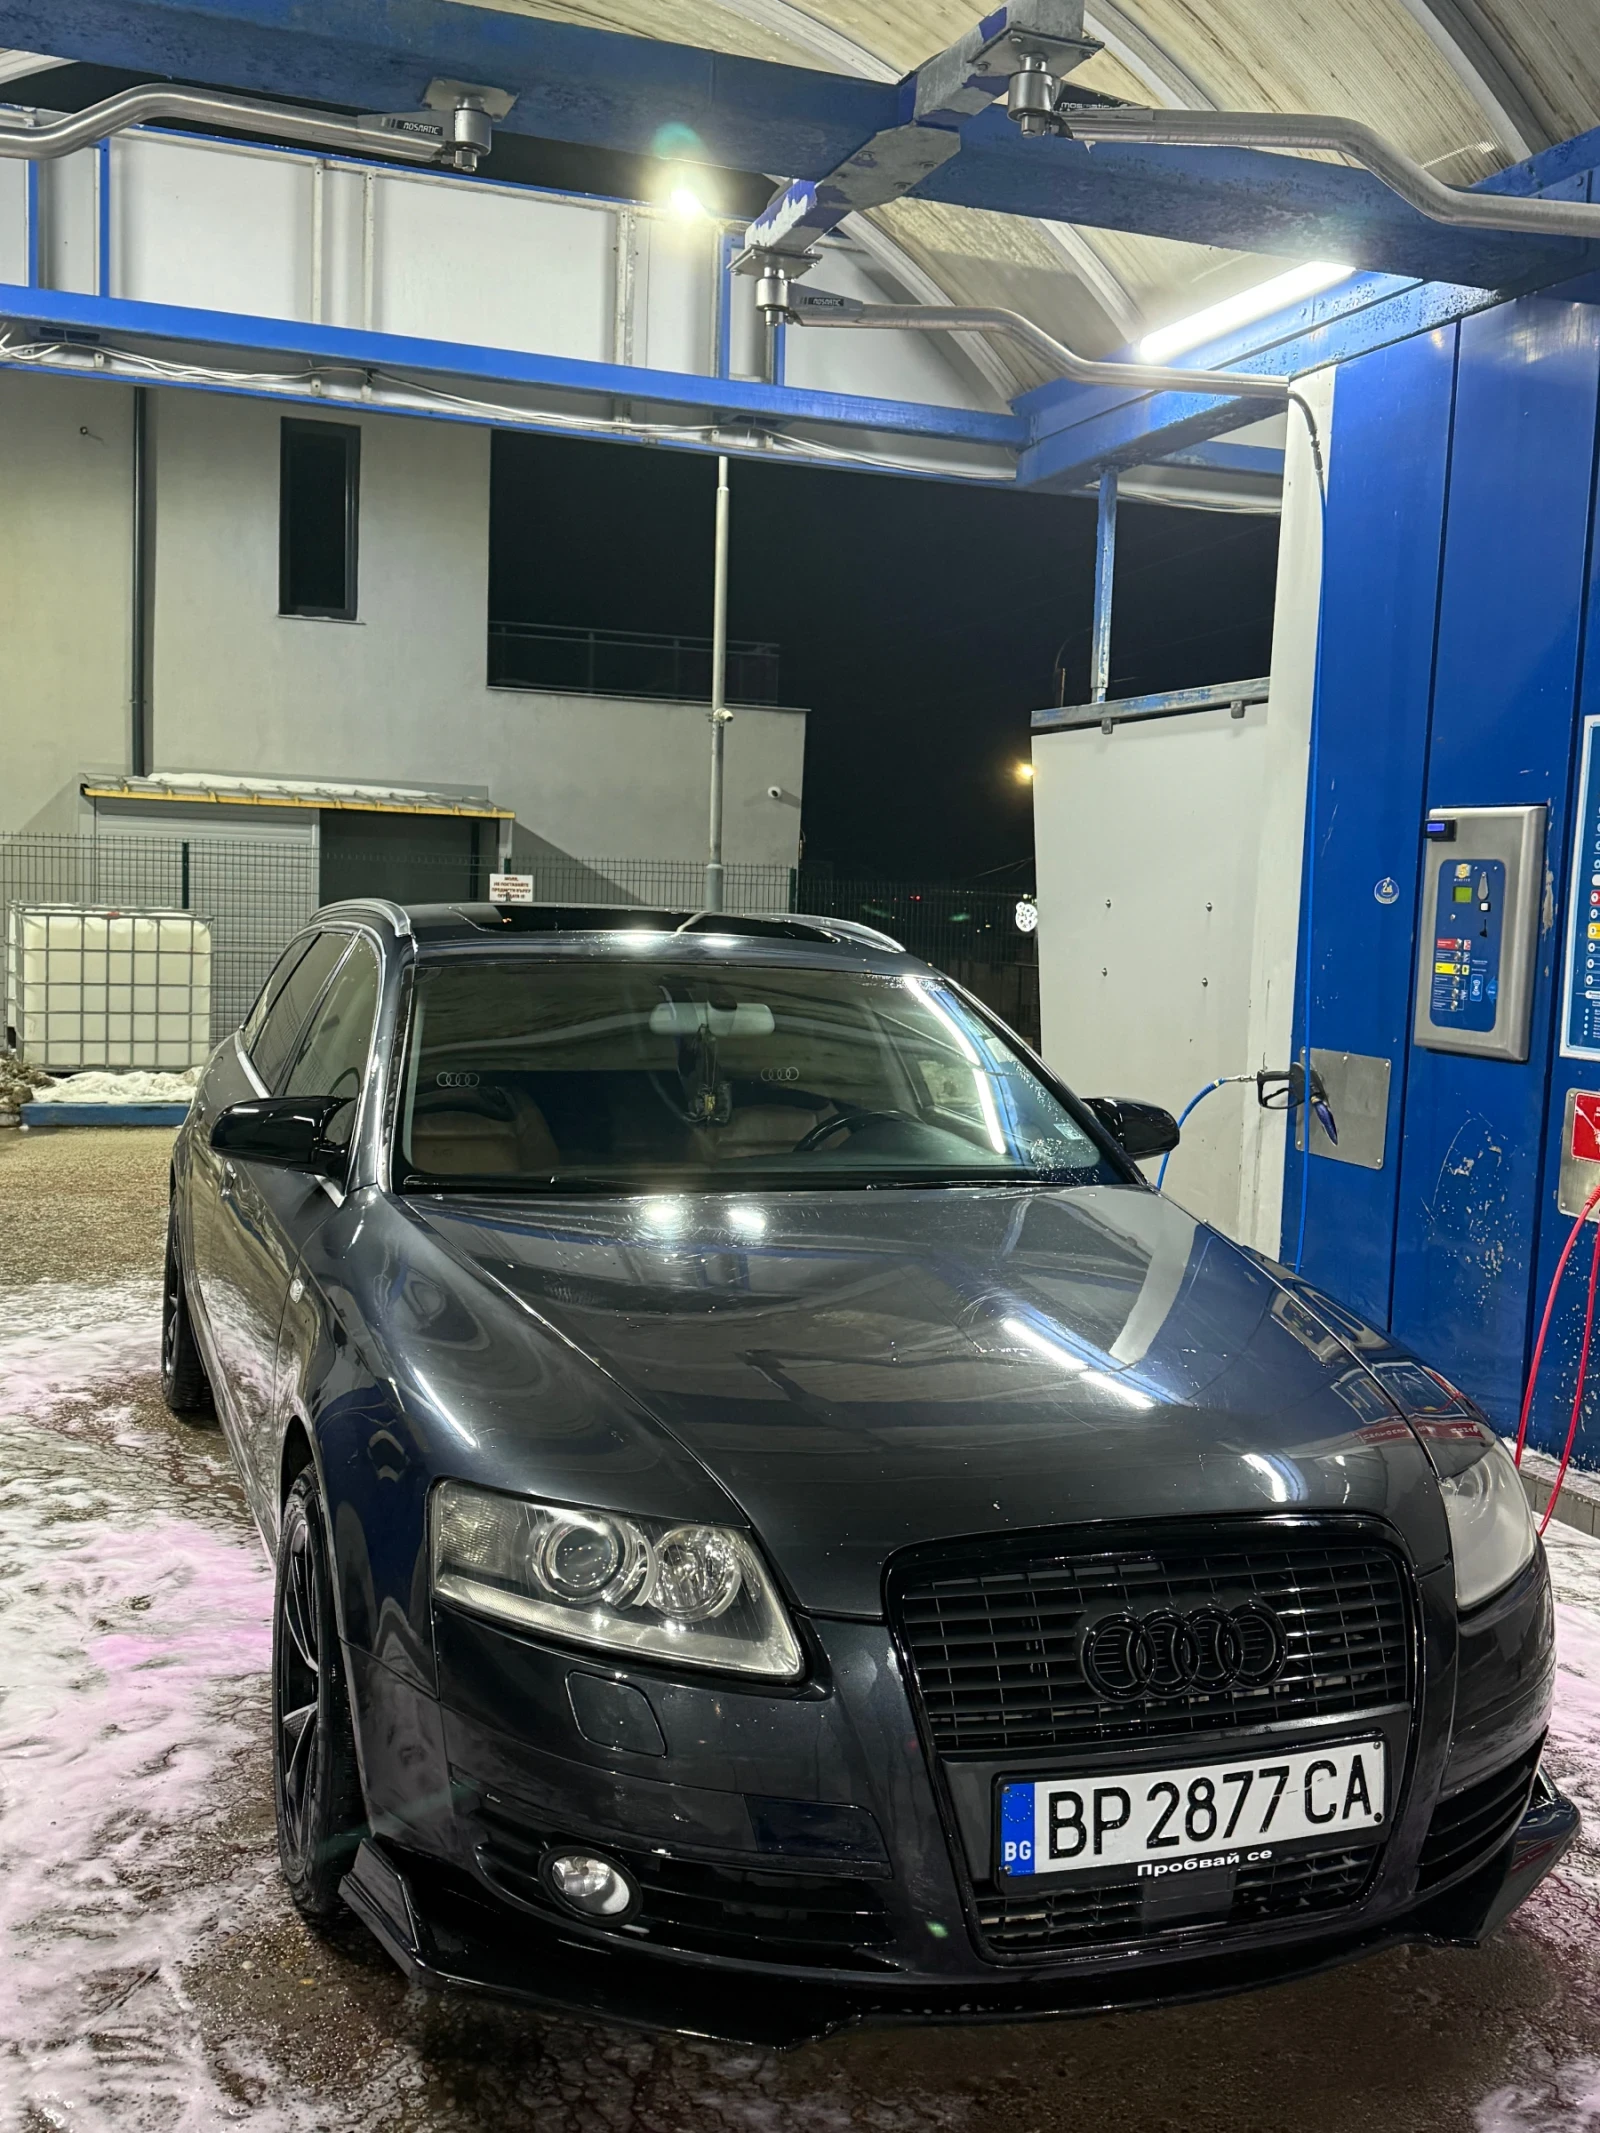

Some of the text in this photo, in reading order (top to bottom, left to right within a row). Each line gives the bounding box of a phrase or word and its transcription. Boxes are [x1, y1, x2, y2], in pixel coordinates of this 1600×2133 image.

[1049, 1754, 1373, 1860] BP 2877 CA
[1004, 1841, 1032, 1861] BG
[1137, 1849, 1273, 1877] Пробвай се
